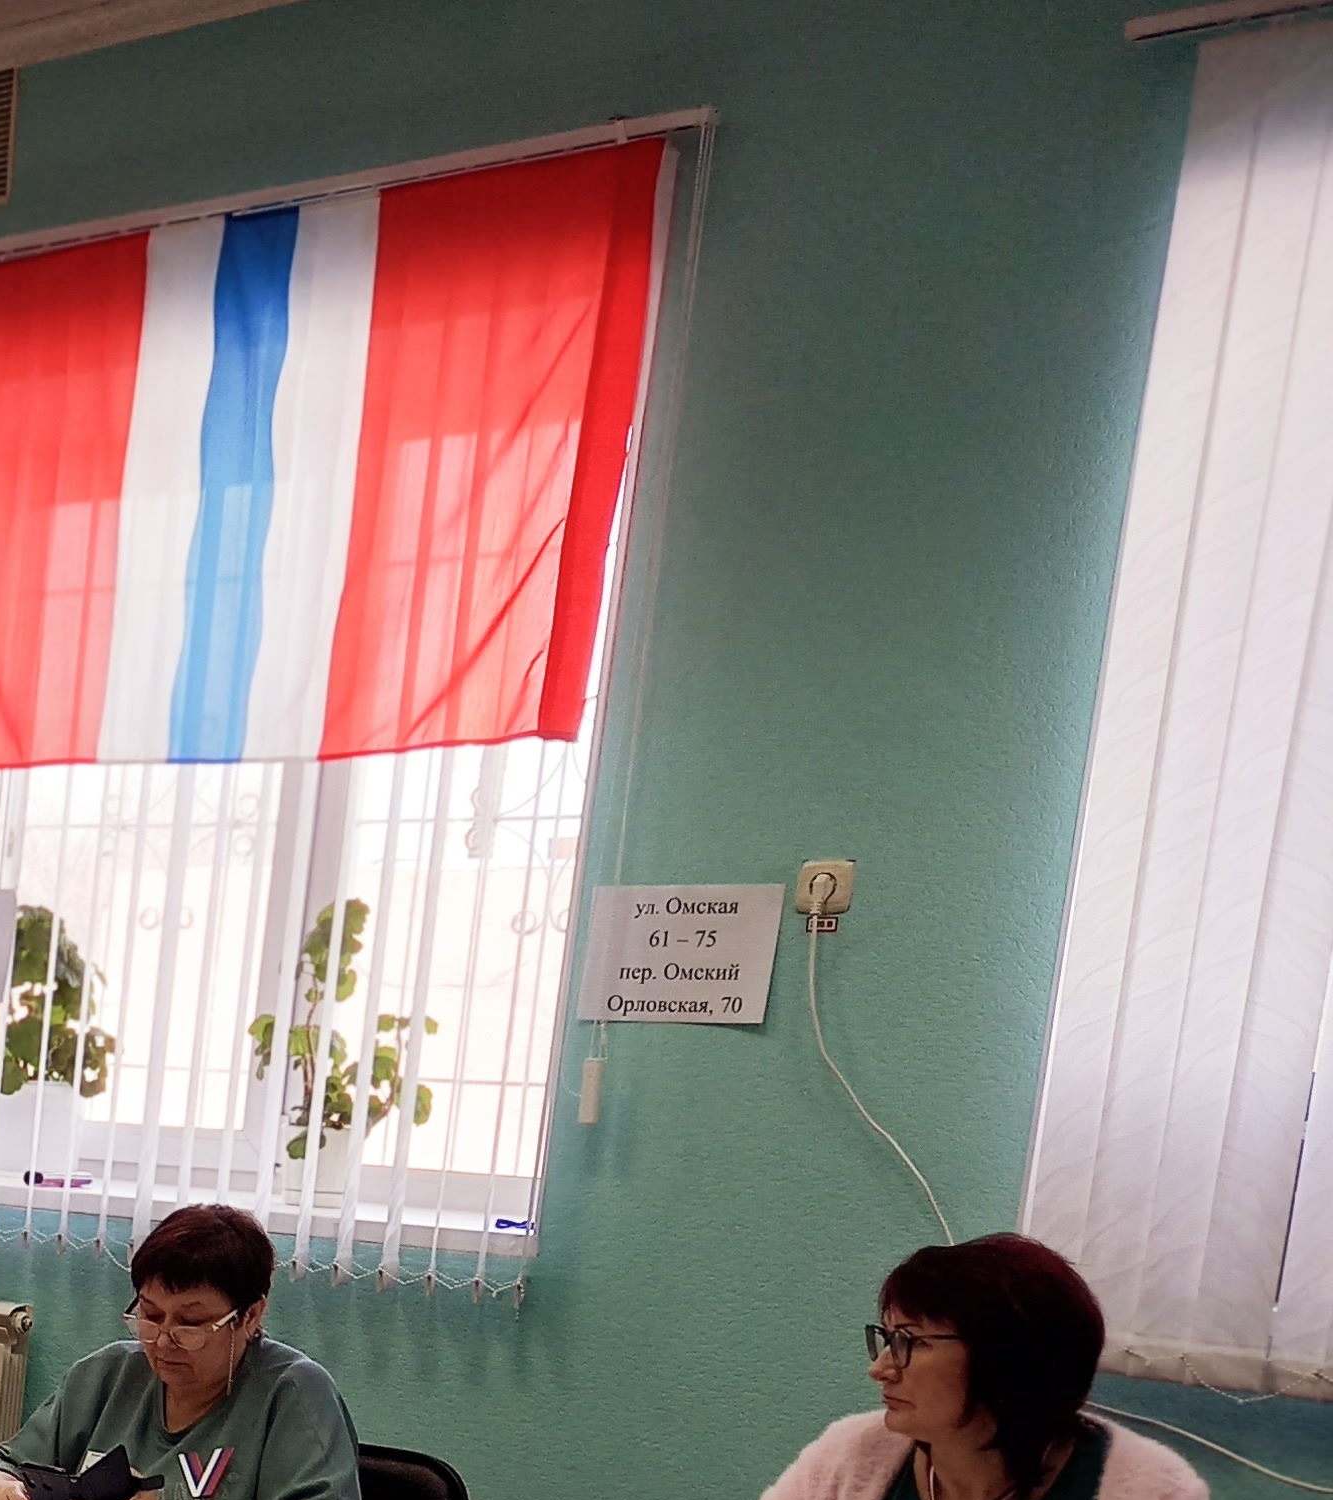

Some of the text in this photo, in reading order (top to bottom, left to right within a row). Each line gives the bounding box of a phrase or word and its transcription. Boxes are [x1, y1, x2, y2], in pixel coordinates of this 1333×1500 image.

[634, 897, 739, 918] ул. Омская
[649, 930, 669, 948] 61
[696, 930, 717, 948] 75
[619, 963, 740, 984] пер. Омский
[607, 994, 742, 1016] Орловская, 70
